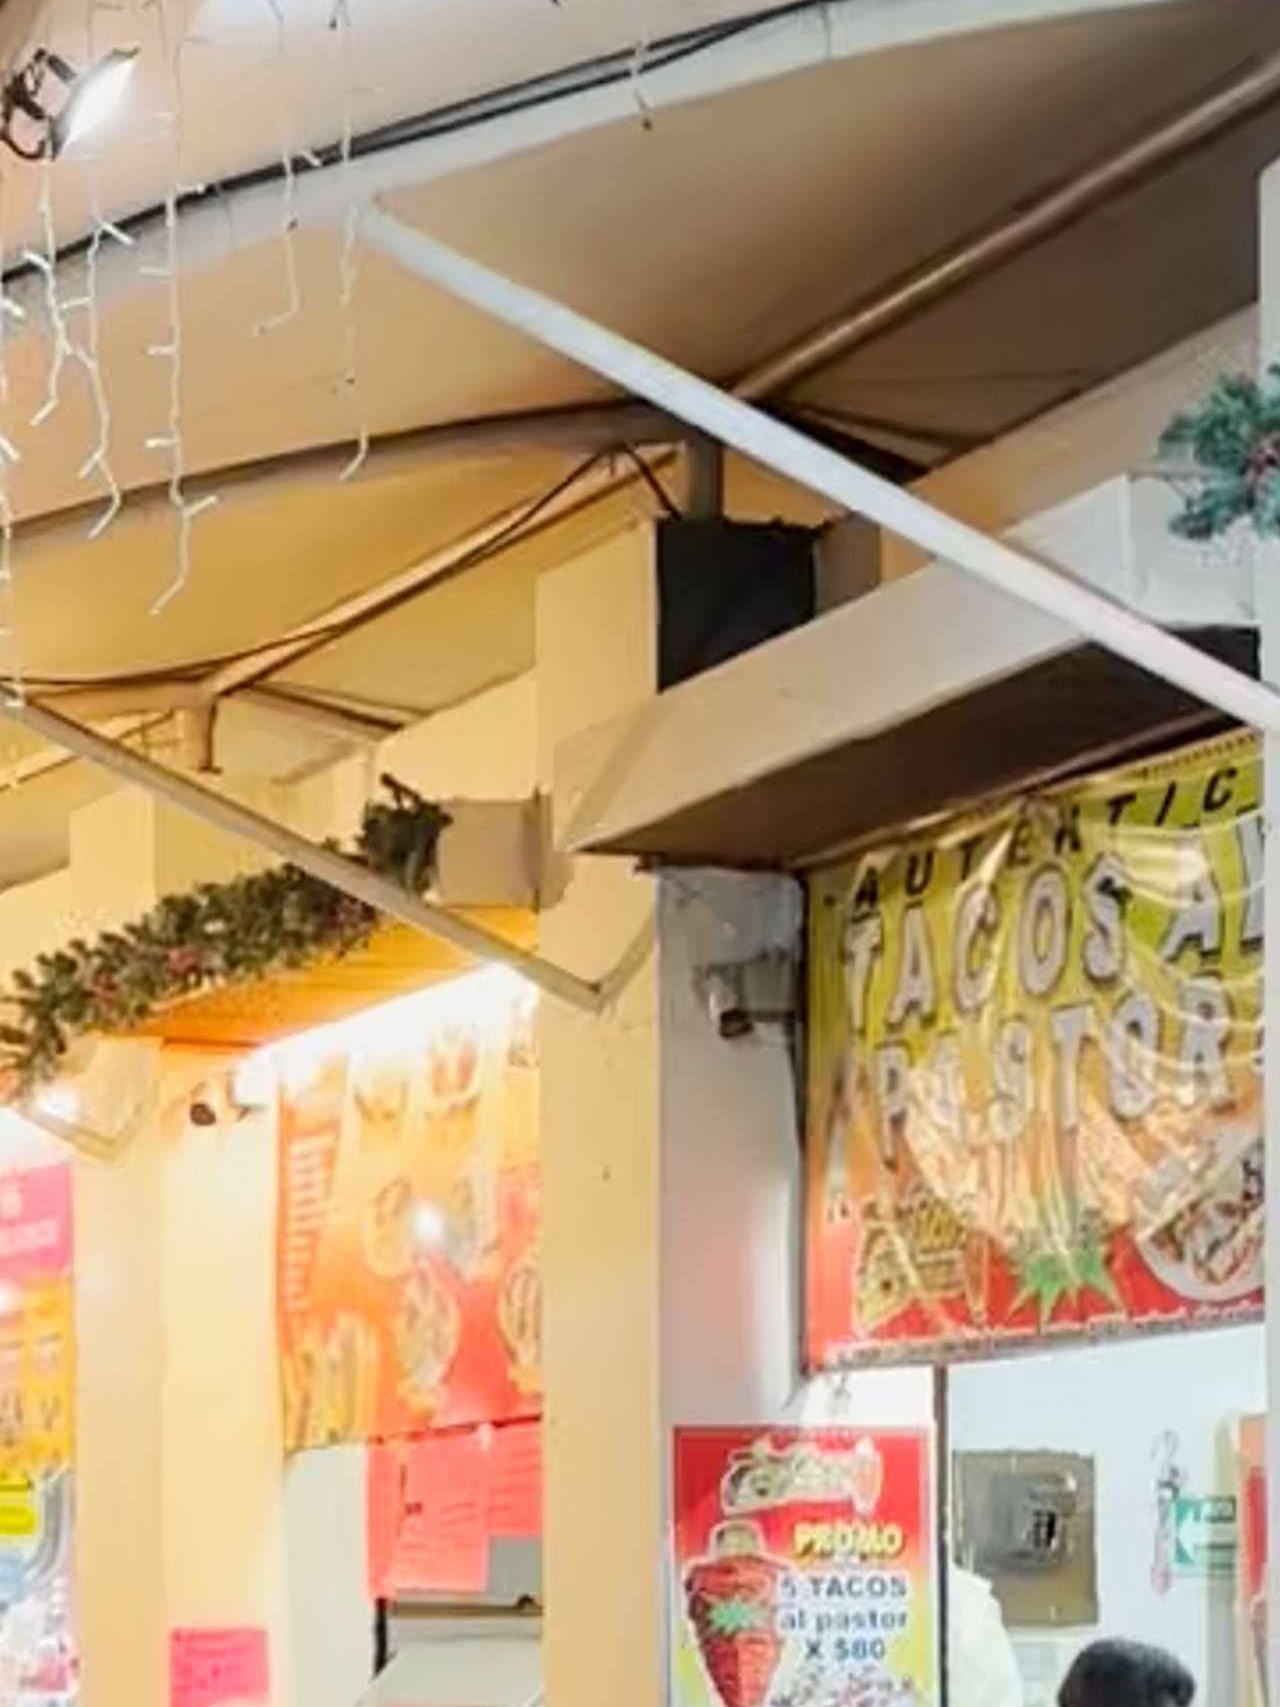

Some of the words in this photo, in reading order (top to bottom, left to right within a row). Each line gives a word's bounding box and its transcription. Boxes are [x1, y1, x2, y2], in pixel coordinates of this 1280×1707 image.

[842, 851, 1130, 1038] TACOS
[875, 970, 1234, 1173] PASTOR
[793, 1522, 904, 1559] PROMO
[809, 1576, 907, 1597] TACOS
[781, 1609, 806, 1630] al
[815, 1610, 908, 1634] pastor
[804, 1638, 823, 1661] X
